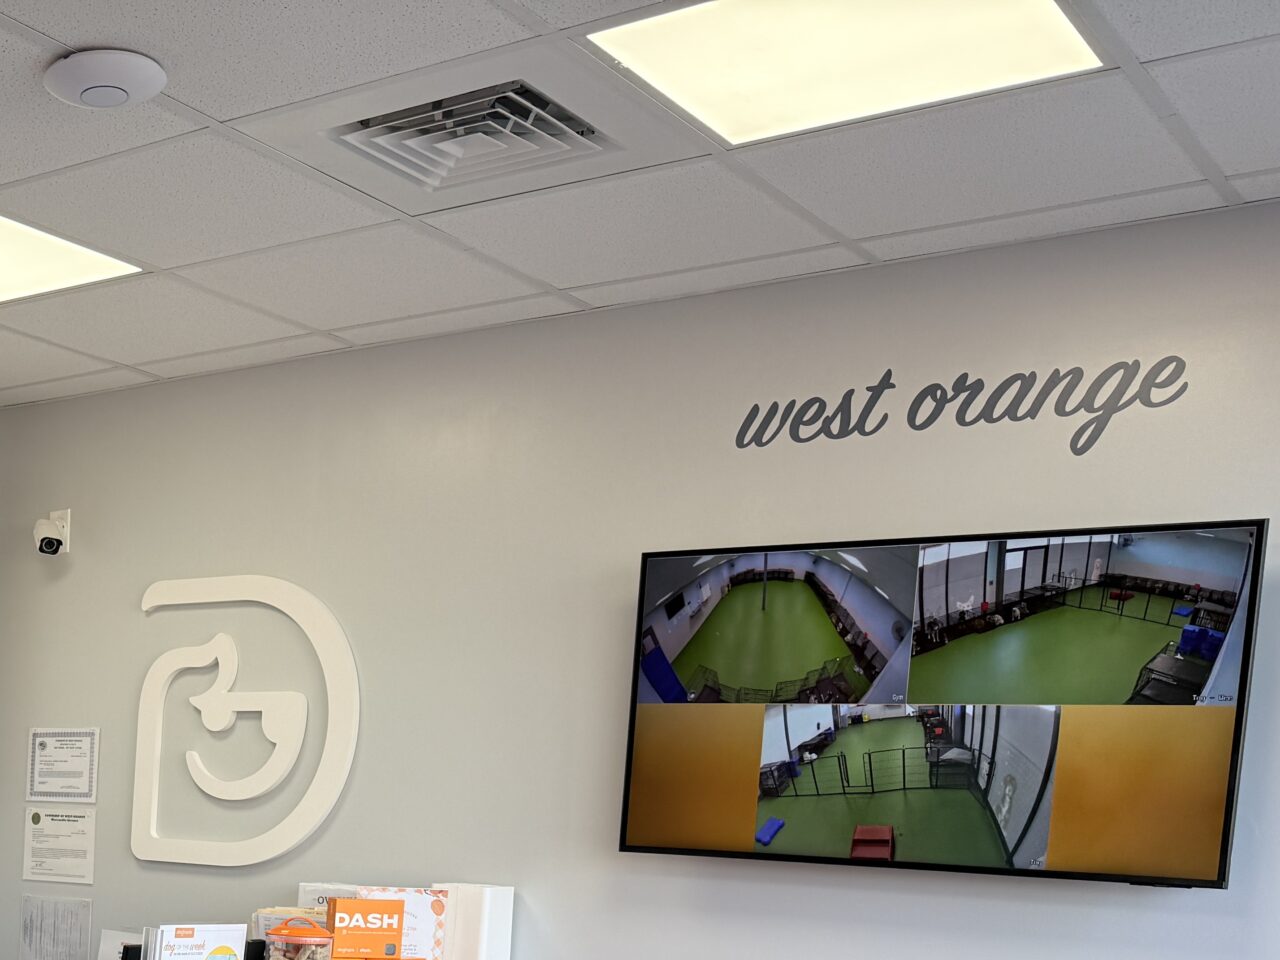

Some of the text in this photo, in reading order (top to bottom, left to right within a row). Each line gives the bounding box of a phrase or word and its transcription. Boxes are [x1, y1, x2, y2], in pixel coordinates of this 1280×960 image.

[734, 355, 1189, 456] west orange
[335, 912, 399, 929] DASH
